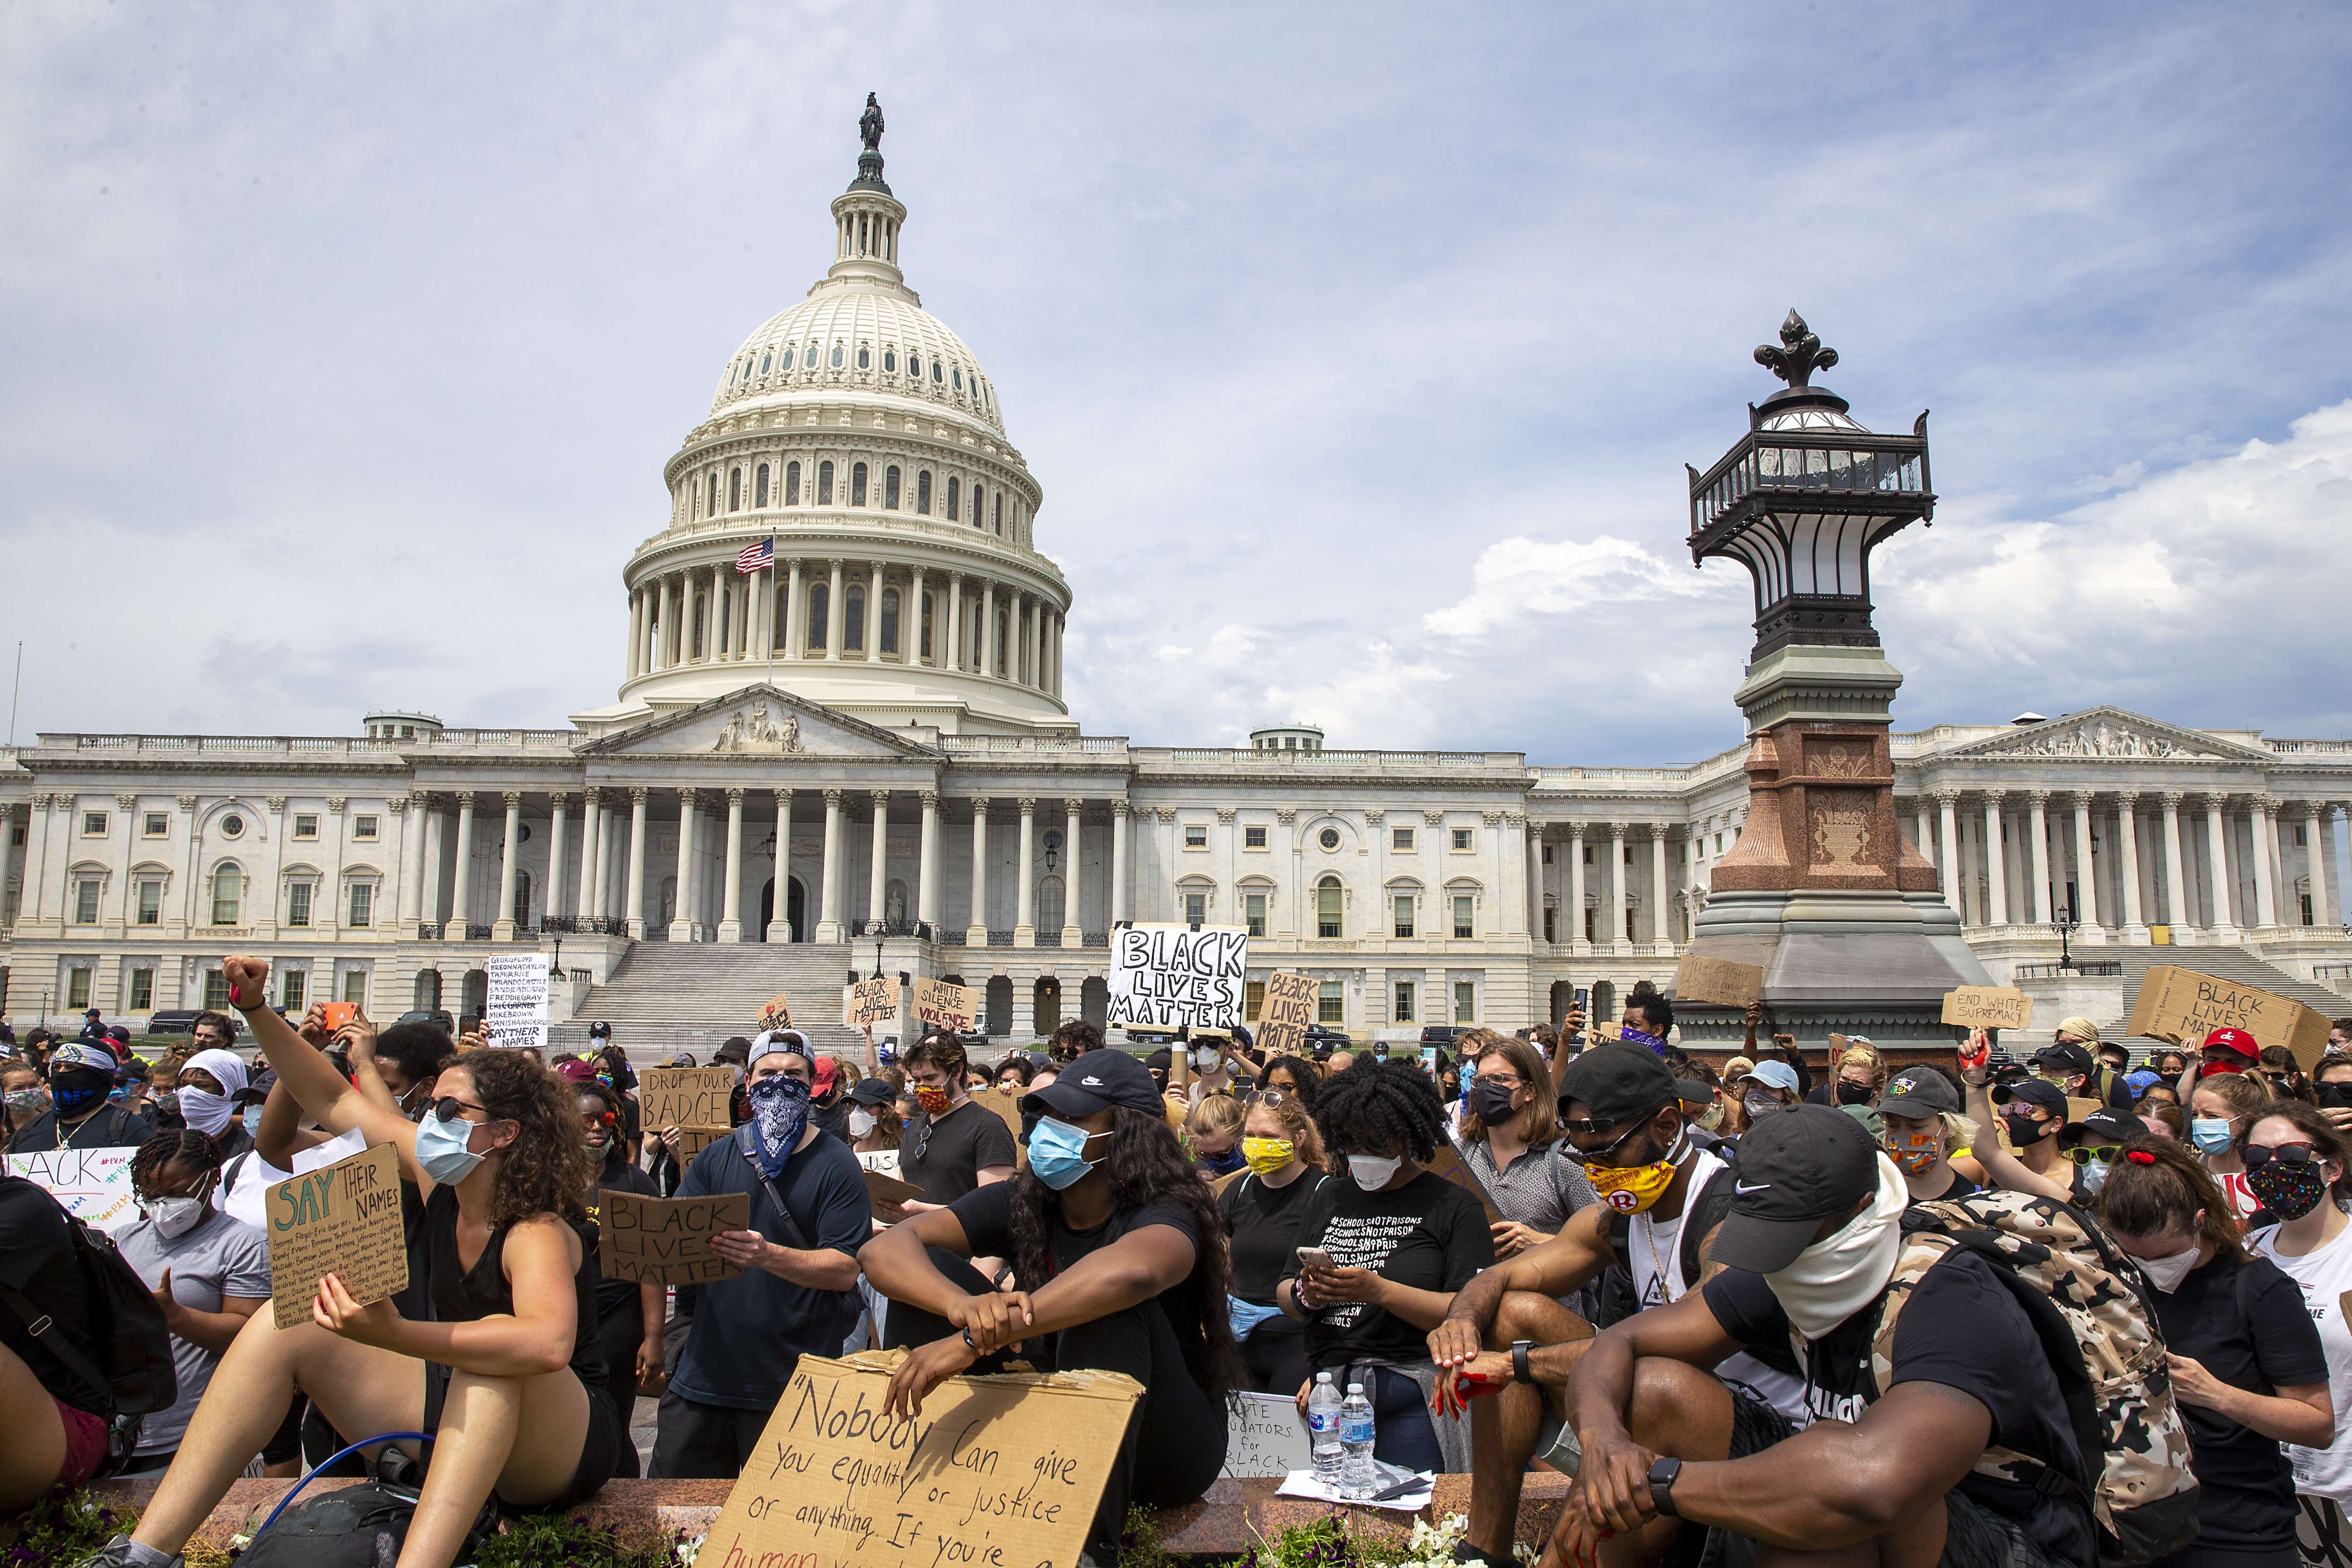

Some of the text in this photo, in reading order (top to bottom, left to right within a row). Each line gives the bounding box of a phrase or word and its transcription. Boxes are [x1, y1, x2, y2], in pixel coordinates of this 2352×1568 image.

[1123, 931, 1247, 978] BLACK
[1685, 957, 1711, 975] THE
[854, 981, 886, 999] BLACK
[933, 982, 962, 999] WHITE
[1133, 971, 1234, 1007] LIVES
[1707, 979, 1717, 988] TO
[864, 994, 890, 1008] LIVES
[921, 990, 965, 1009] SILENCE
[1958, 994, 2027, 1011] END WHITE
[2198, 982, 2264, 1014] BLACK
[854, 1006, 896, 1023] MATTER
[919, 1007, 970, 1029] VIOLENCE
[1107, 994, 1236, 1029] MATTER
[1271, 999, 1311, 1026] LIVES
[1957, 1007, 2021, 1025] SUPREMACY
[2193, 1001, 2248, 1030] LIVES
[2180, 1016, 2219, 1038] MAT
[502, 1037, 535, 1047] NAMES
[650, 1073, 732, 1090] DROP YOUR
[644, 1092, 730, 1127] BADGE
[275, 1162, 377, 1231] SAY THEIR
[356, 1189, 398, 1221] NAMES
[1611, 1194, 1634, 1208] R
[610, 1197, 738, 1233] BLACK
[380, 1223, 401, 1235] Stephon
[1325, 1226, 1413, 1237] #SCHOOLSNOTPRISON
[273, 1238, 294, 1251] George
[274, 1273, 289, 1283] Clark
[951, 1419, 999, 1476] Can
[1017, 1449, 1077, 1501] give
[832, 1456, 921, 1512] equality
[928, 1487, 950, 1504] or
[796, 1502, 878, 1551] anything.
[887, 1513, 923, 1549] If
[930, 1529, 1004, 1568] you're
